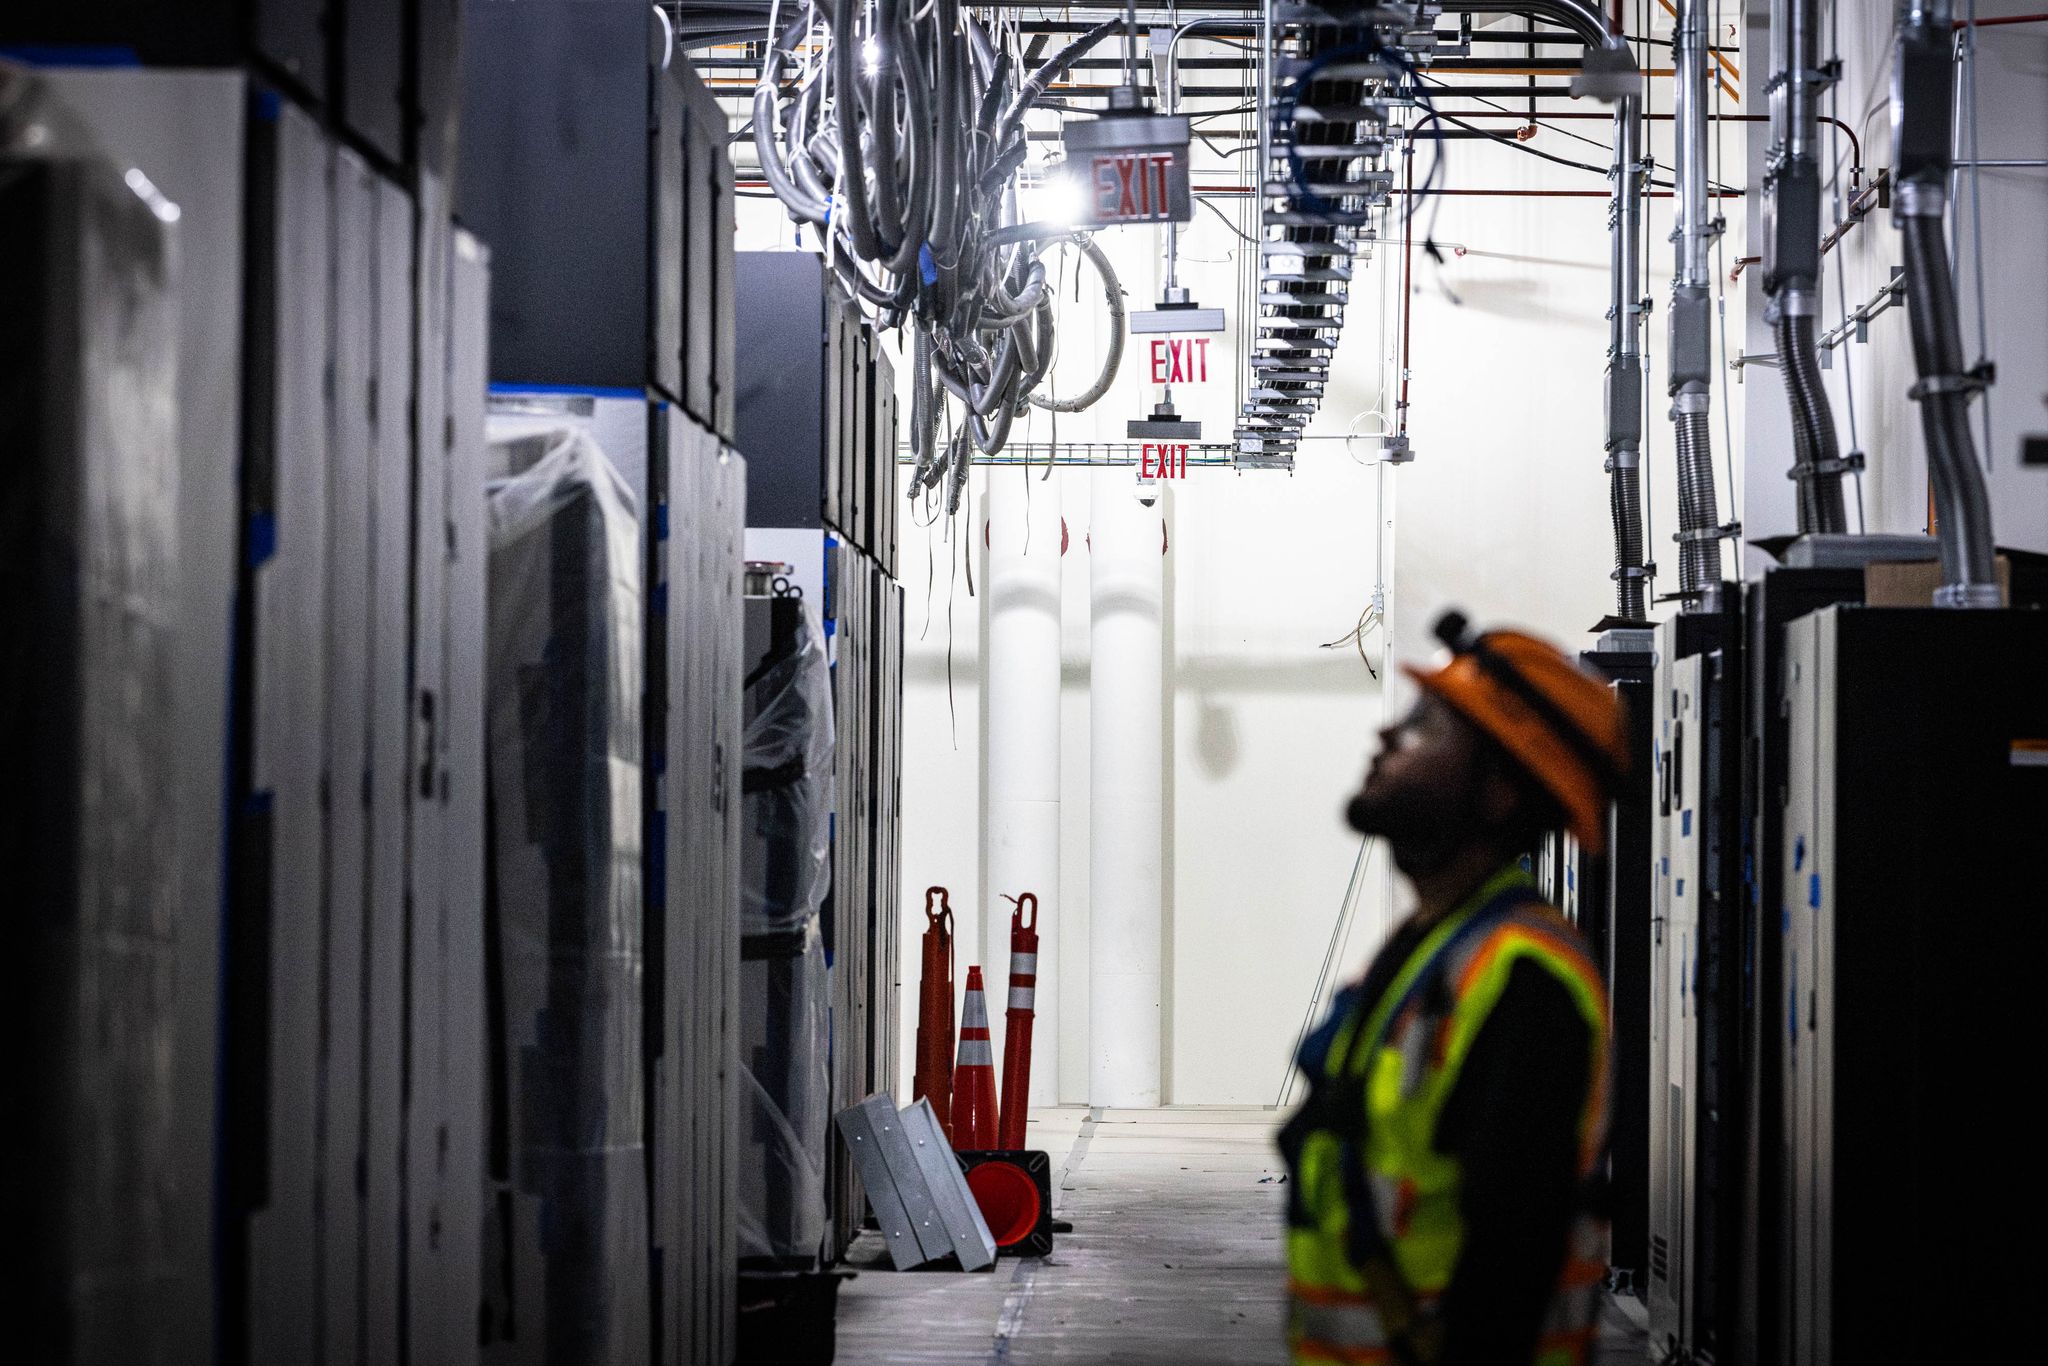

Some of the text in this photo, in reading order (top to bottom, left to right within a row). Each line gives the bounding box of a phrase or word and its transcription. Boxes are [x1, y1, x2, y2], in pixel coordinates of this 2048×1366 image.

[1091, 152, 1173, 219] EXIT
[1151, 338, 1209, 383] EXIT
[1142, 444, 1189, 479] EXIT
